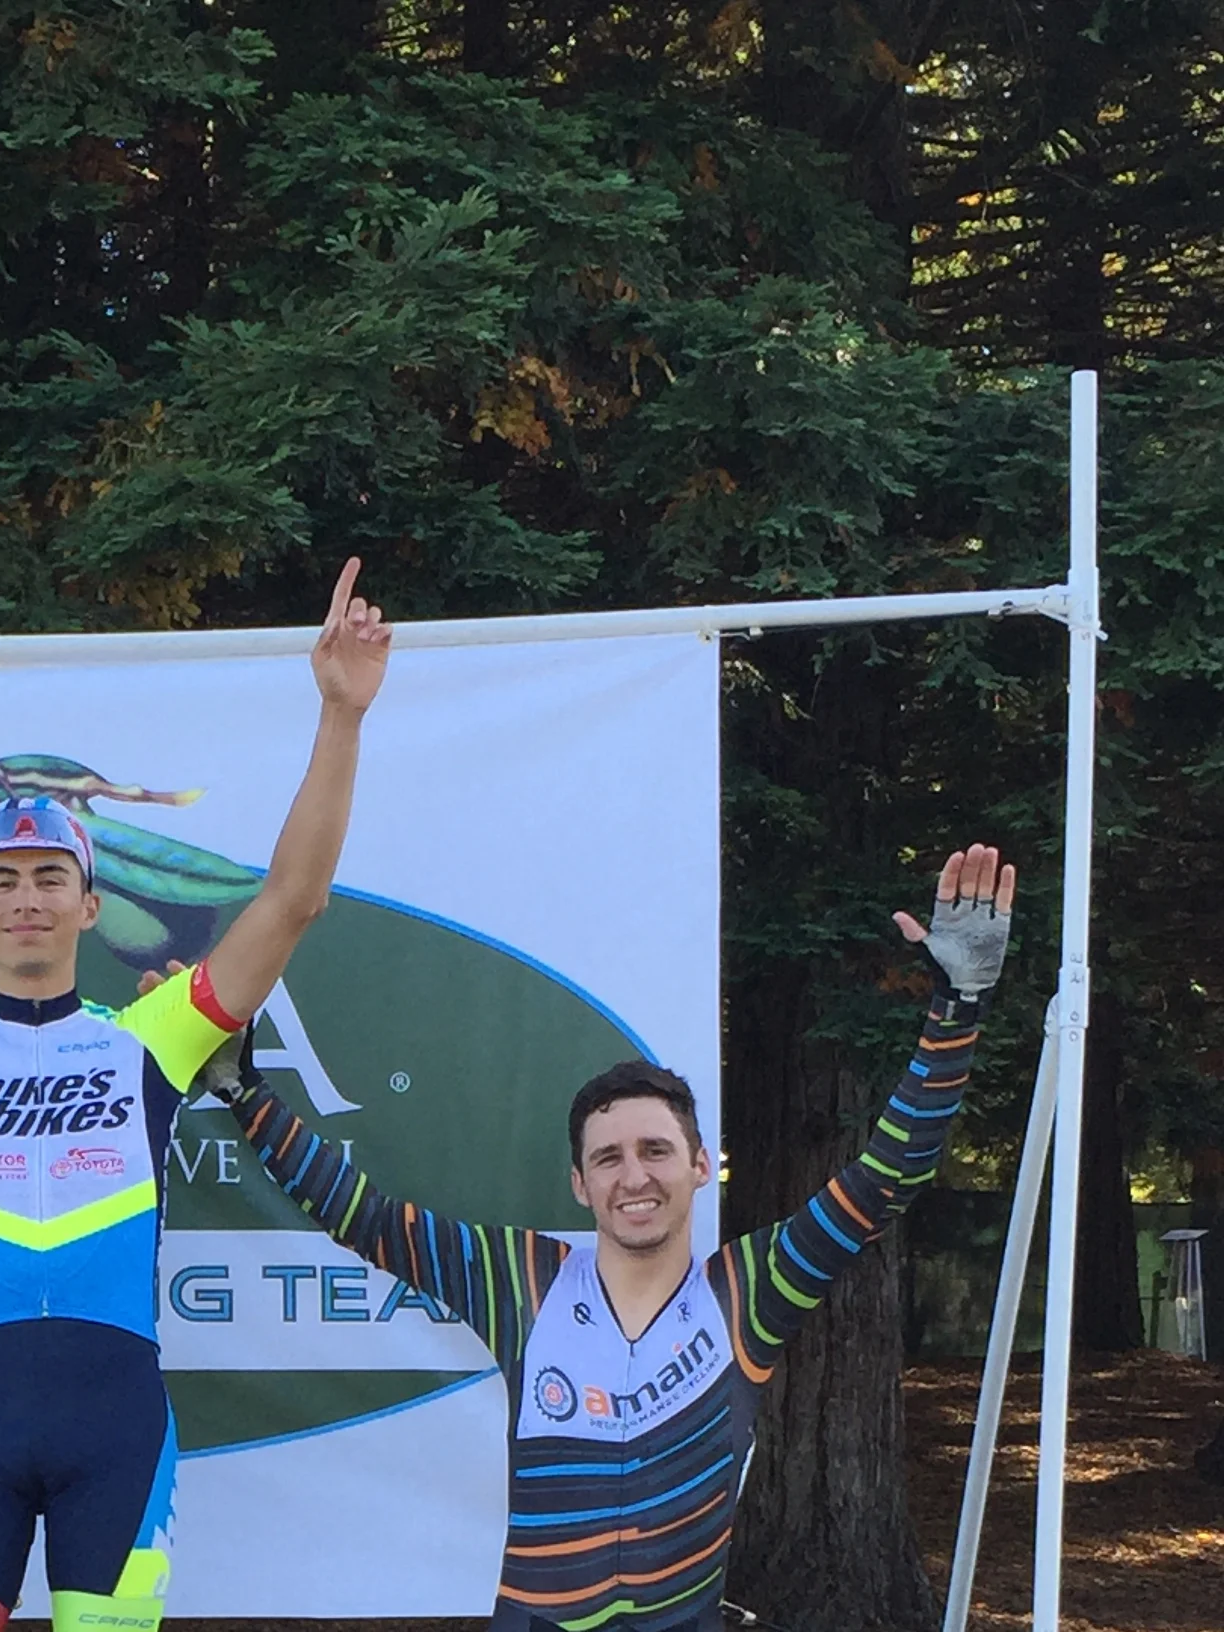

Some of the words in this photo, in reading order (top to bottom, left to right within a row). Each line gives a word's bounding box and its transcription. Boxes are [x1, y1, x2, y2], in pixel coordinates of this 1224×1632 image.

[75, 1158, 124, 1172] TOYOTA
[262, 1265, 462, 1323] TEA
[583, 1327, 715, 1418] amain
